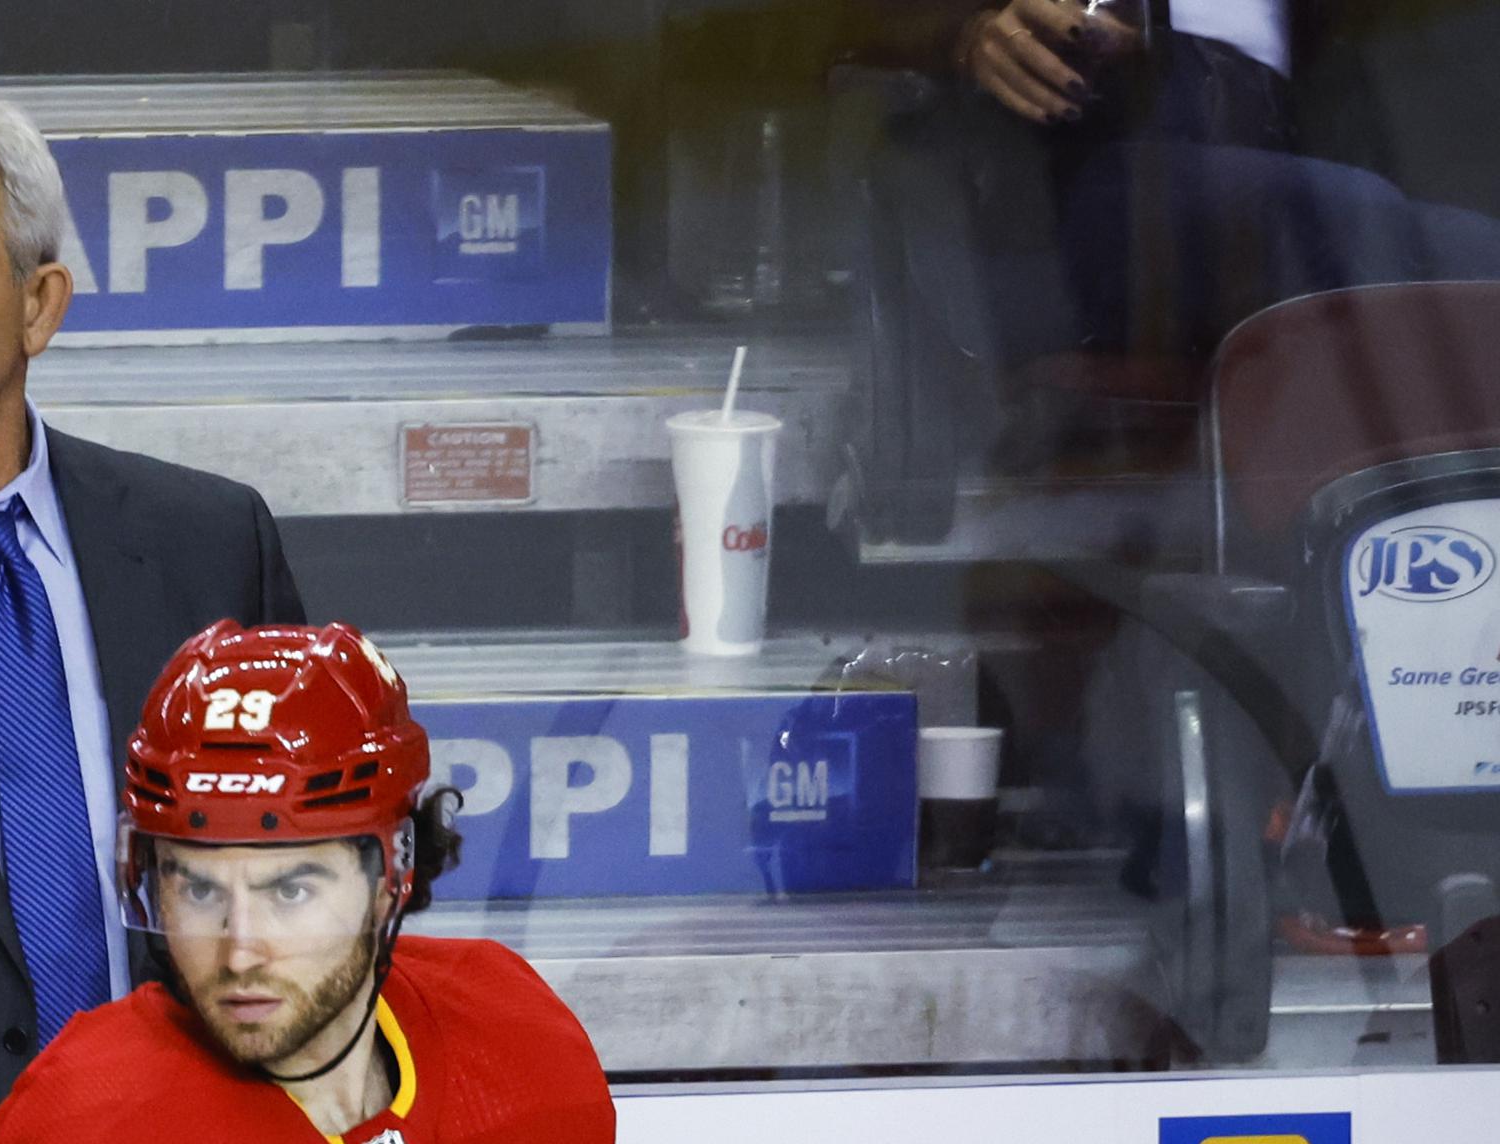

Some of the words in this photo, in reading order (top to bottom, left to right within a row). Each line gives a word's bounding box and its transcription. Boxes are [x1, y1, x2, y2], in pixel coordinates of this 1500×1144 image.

[459, 194, 519, 240] GM
[1359, 535, 1483, 597] JPS
[1388, 667, 1452, 685] Same
[204, 689, 276, 732] 29
[185, 772, 286, 794] CCM
[767, 760, 829, 808] GM
